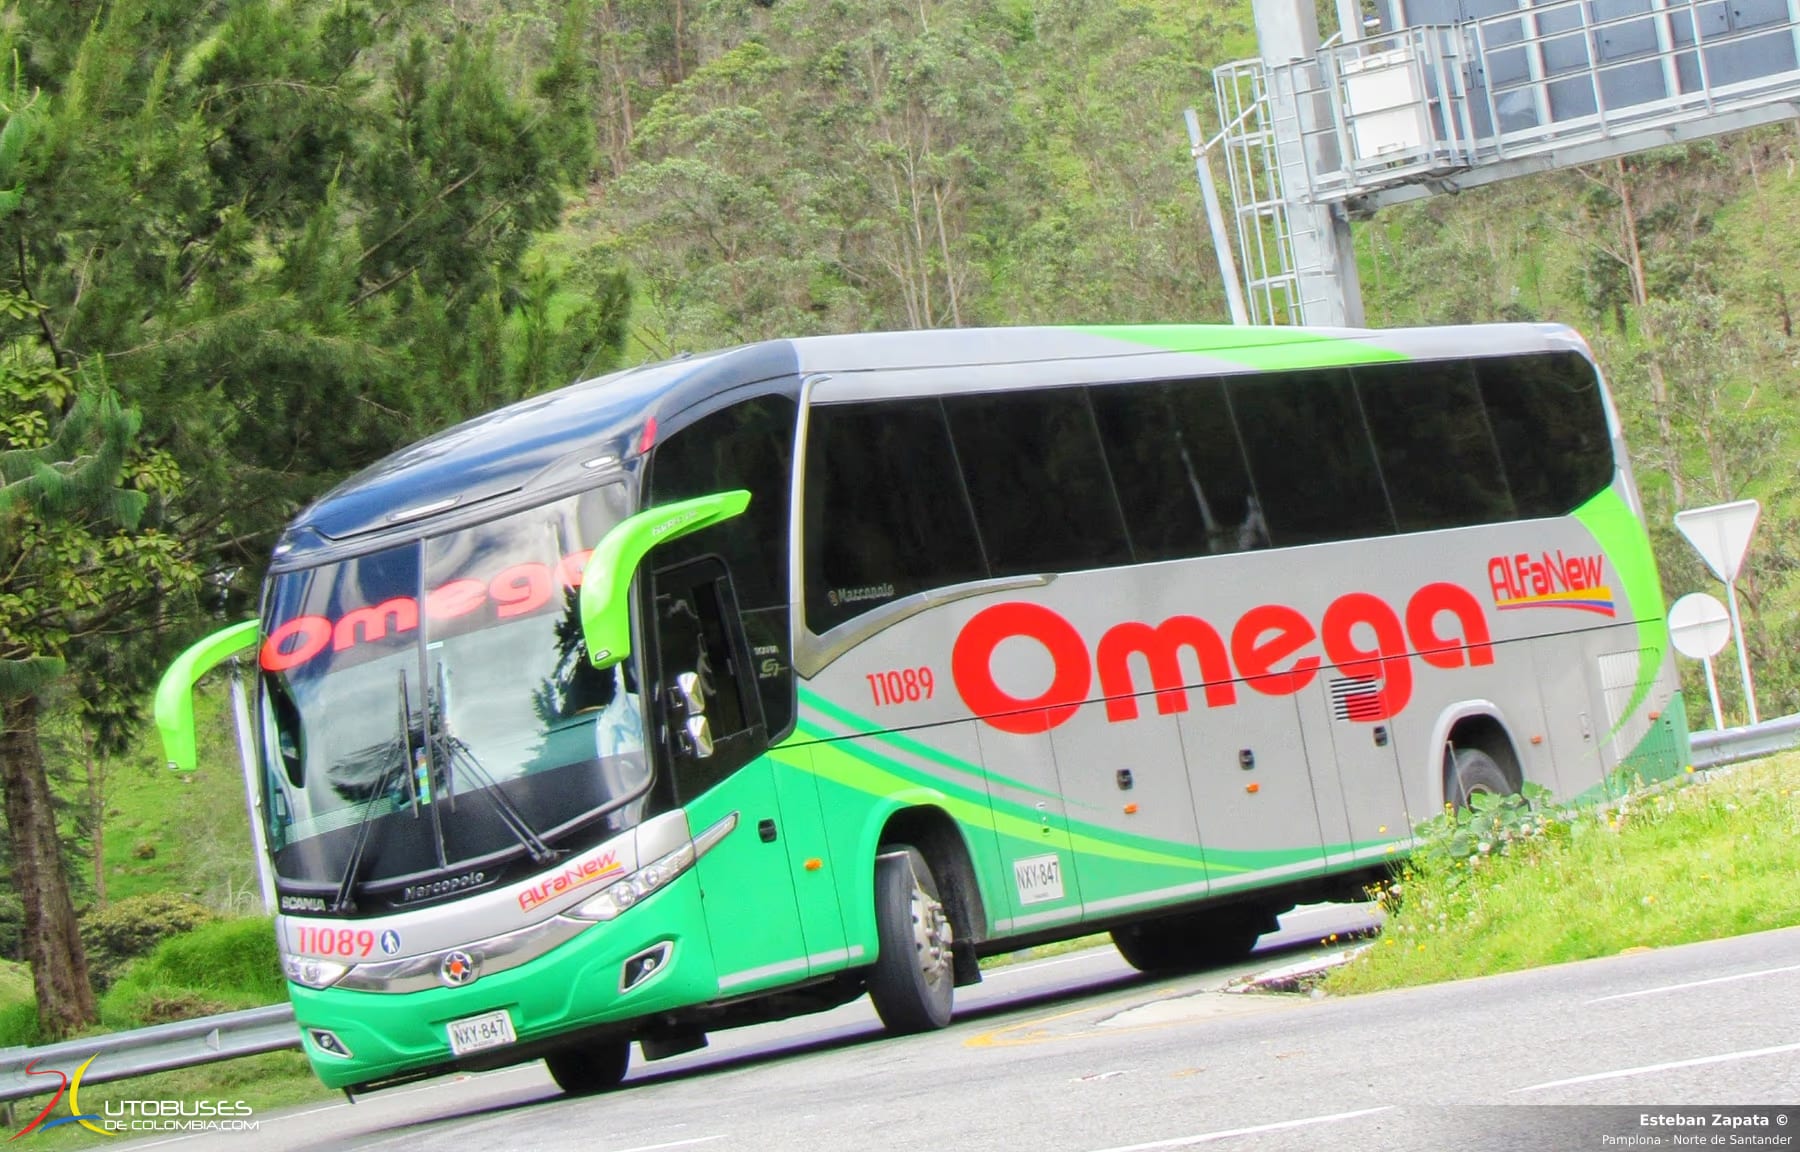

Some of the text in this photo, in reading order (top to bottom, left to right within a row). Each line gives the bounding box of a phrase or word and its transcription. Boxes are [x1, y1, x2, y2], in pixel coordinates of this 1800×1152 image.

[952, 581, 1495, 734] Omega
[866, 666, 935, 706] 11089
[404, 871, 484, 900] Marcopolo
[282, 895, 326, 912] SCANIA
[297, 926, 375, 957] 11089
